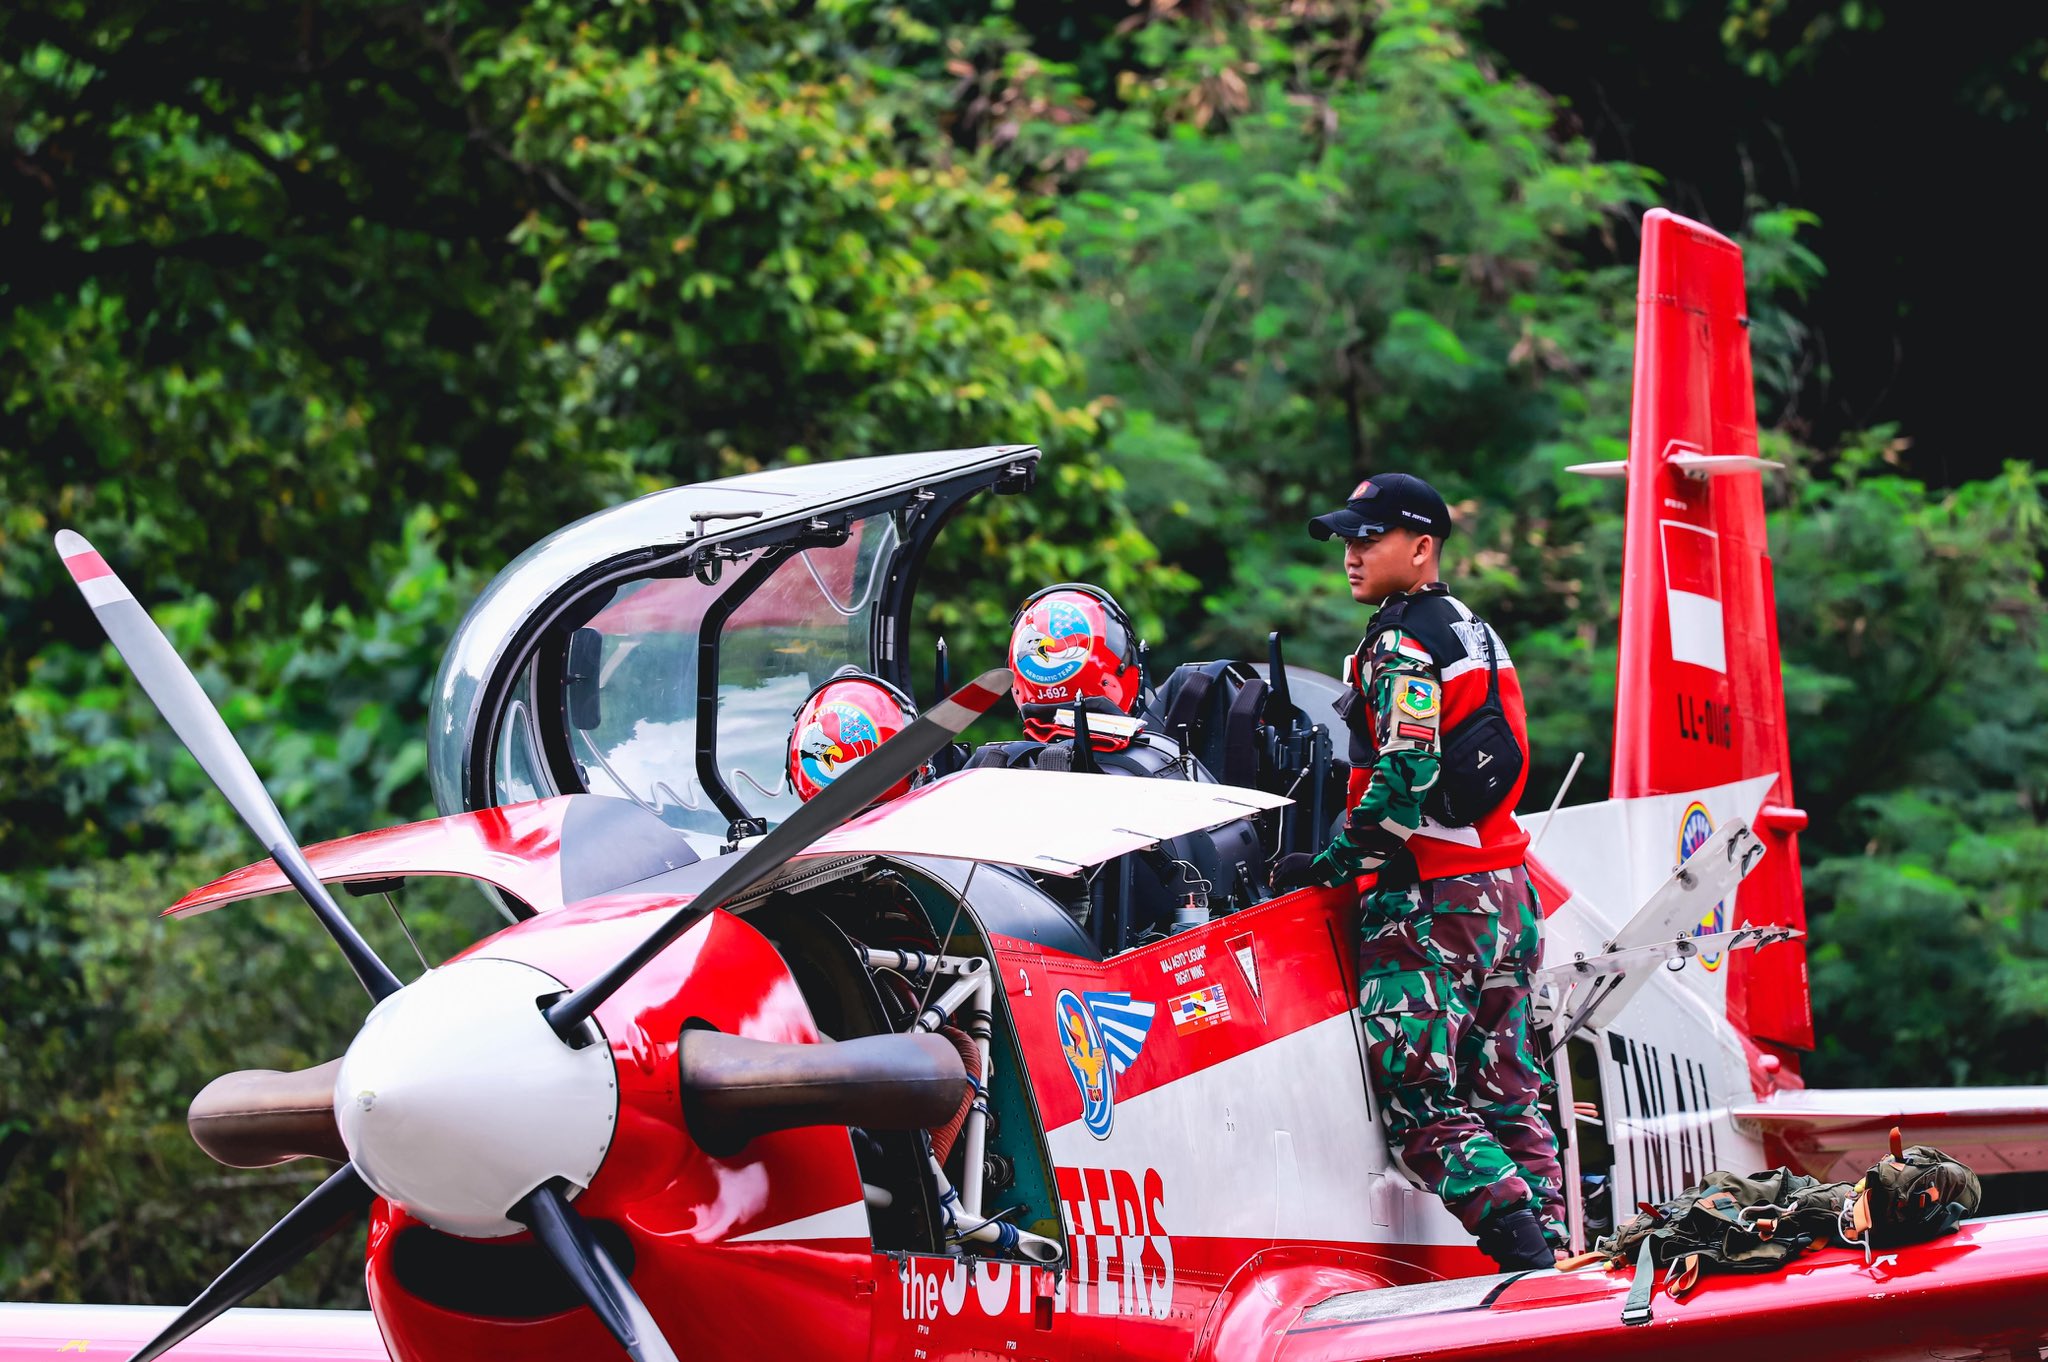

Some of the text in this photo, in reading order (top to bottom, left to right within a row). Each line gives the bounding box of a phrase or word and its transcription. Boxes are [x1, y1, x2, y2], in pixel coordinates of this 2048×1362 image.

[1025, 663, 1075, 682] AEROBATIC TEAM
[1037, 686, 1068, 700] J-692
[815, 704, 861, 724] JUPITER
[1174, 964, 1206, 987] RIGHT WING
[902, 1166, 1175, 1321] the TERS
